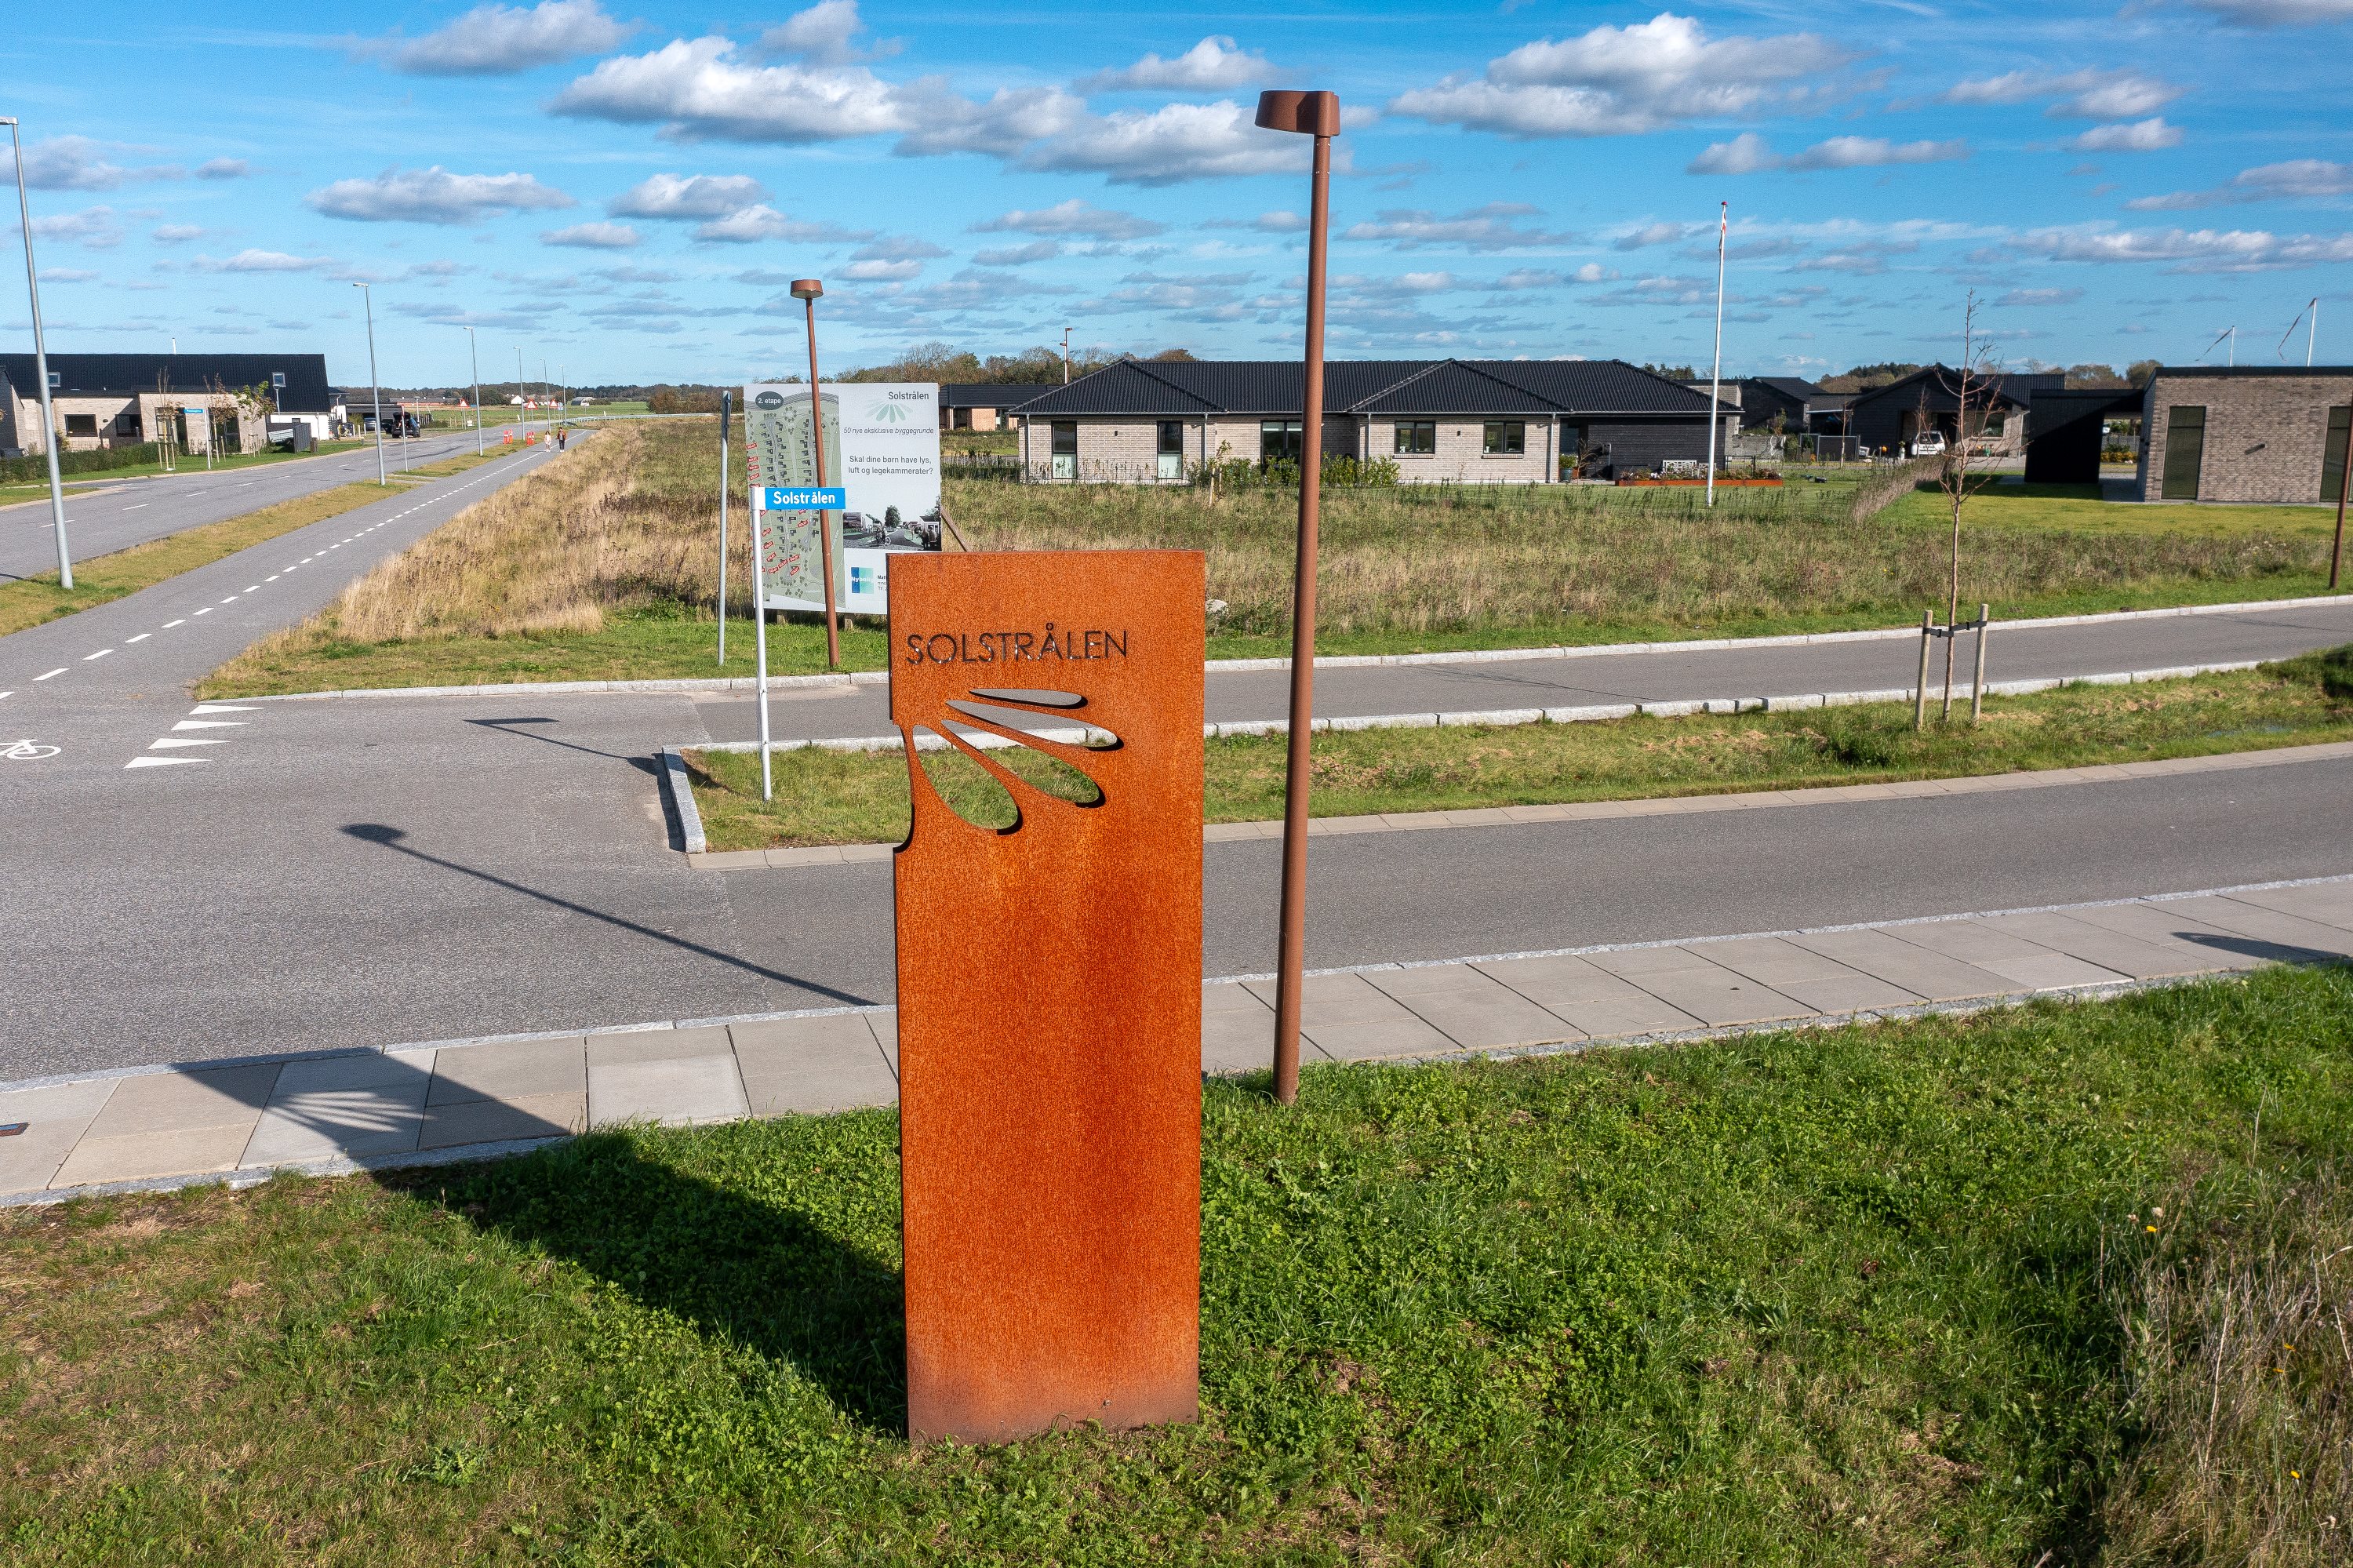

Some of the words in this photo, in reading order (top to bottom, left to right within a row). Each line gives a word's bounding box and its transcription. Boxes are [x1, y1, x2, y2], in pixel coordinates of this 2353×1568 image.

[888, 391, 929, 400] Solstrålen
[871, 467, 933, 475] legekammerater?
[773, 490, 835, 504] Solstrålen
[906, 622, 1128, 665] SOLSTRÅLEN
